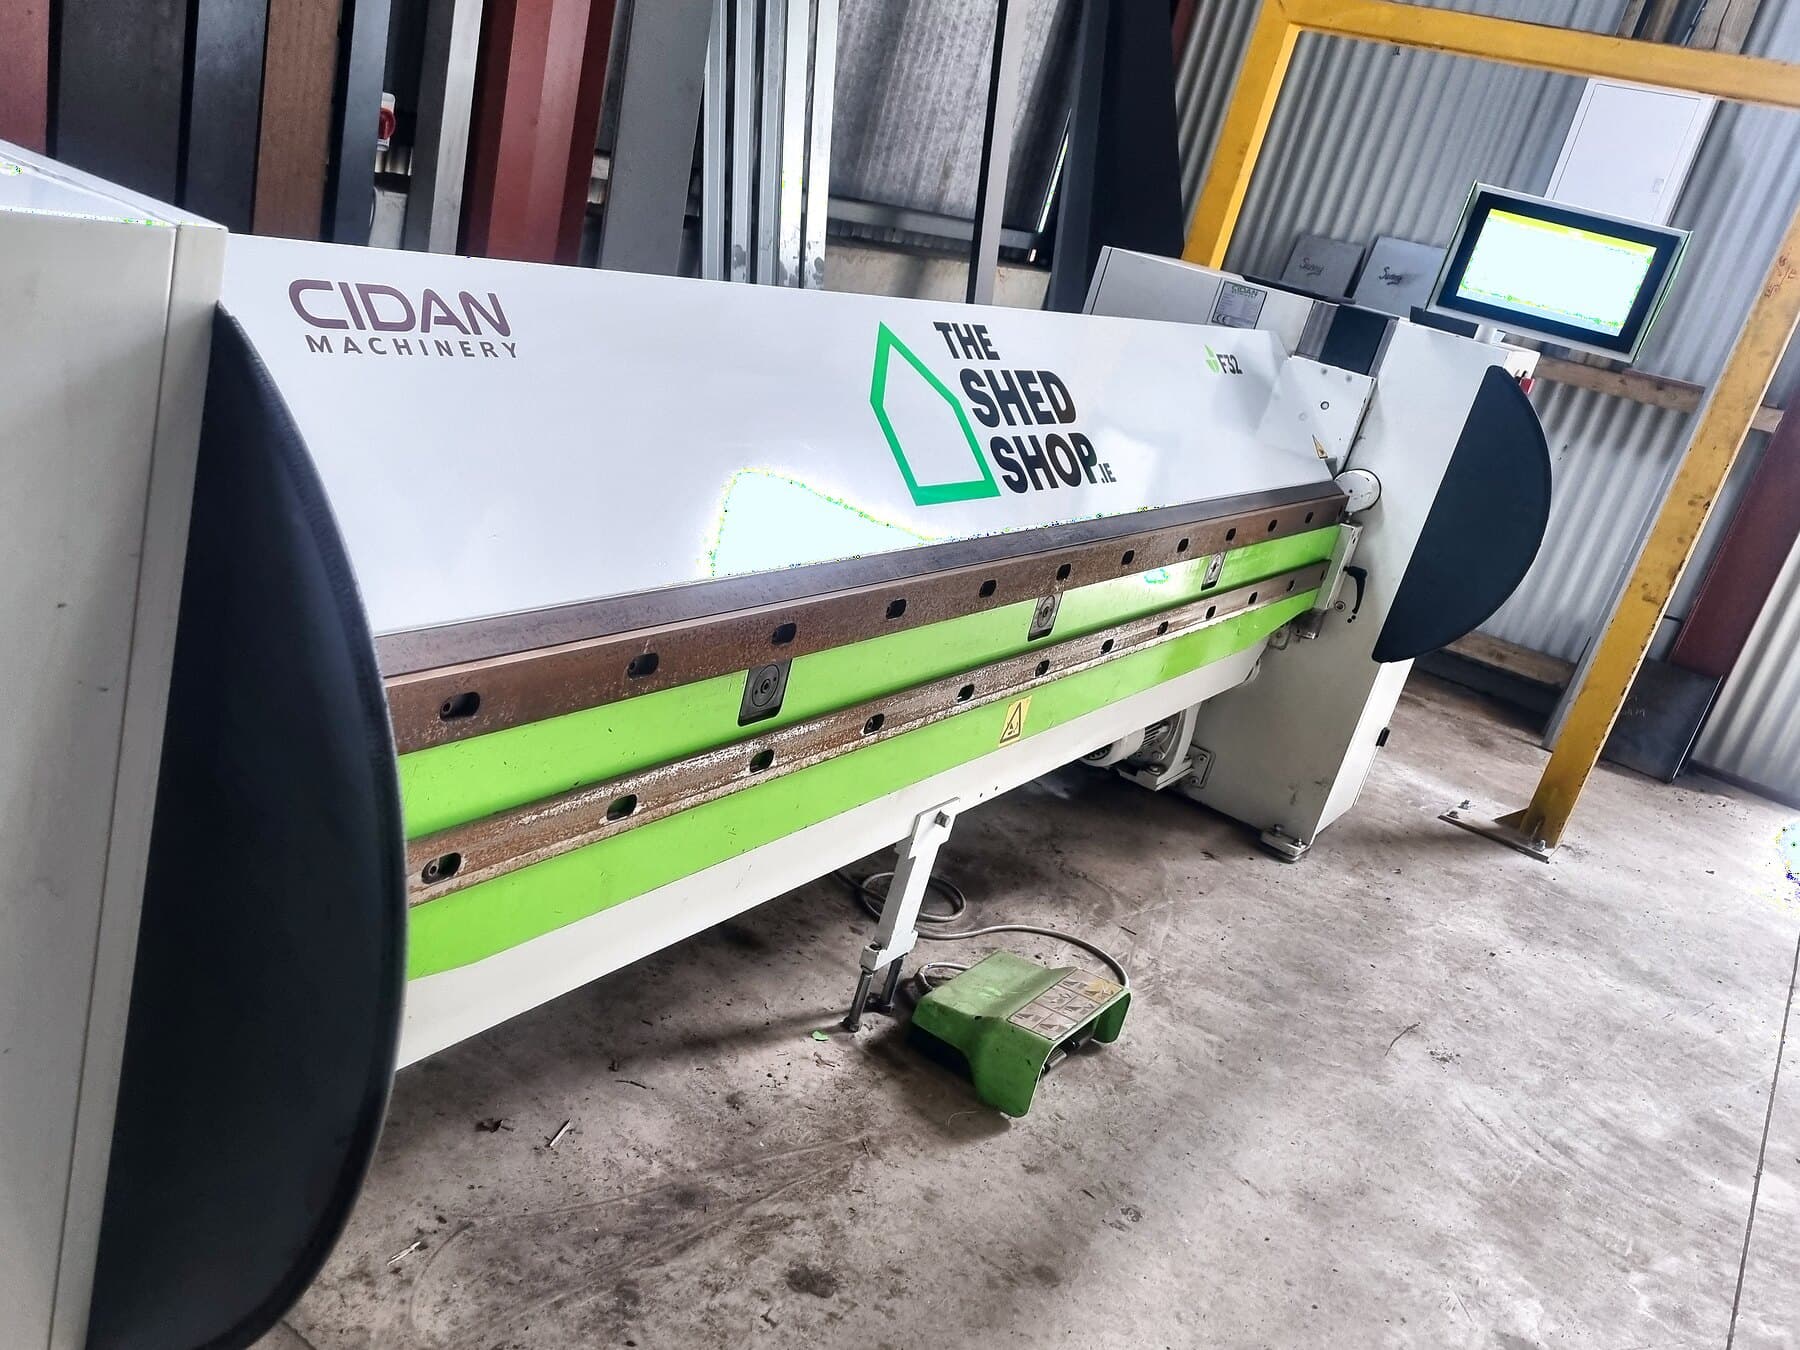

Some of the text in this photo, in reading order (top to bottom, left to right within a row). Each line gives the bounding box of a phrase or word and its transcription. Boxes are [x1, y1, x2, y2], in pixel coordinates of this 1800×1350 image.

[288, 279, 511, 337] CIDAN
[305, 334, 517, 358] MACHINERY
[933, 321, 1000, 360] THE
[1216, 353, 1243, 374] F32
[959, 368, 1077, 428] SHED
